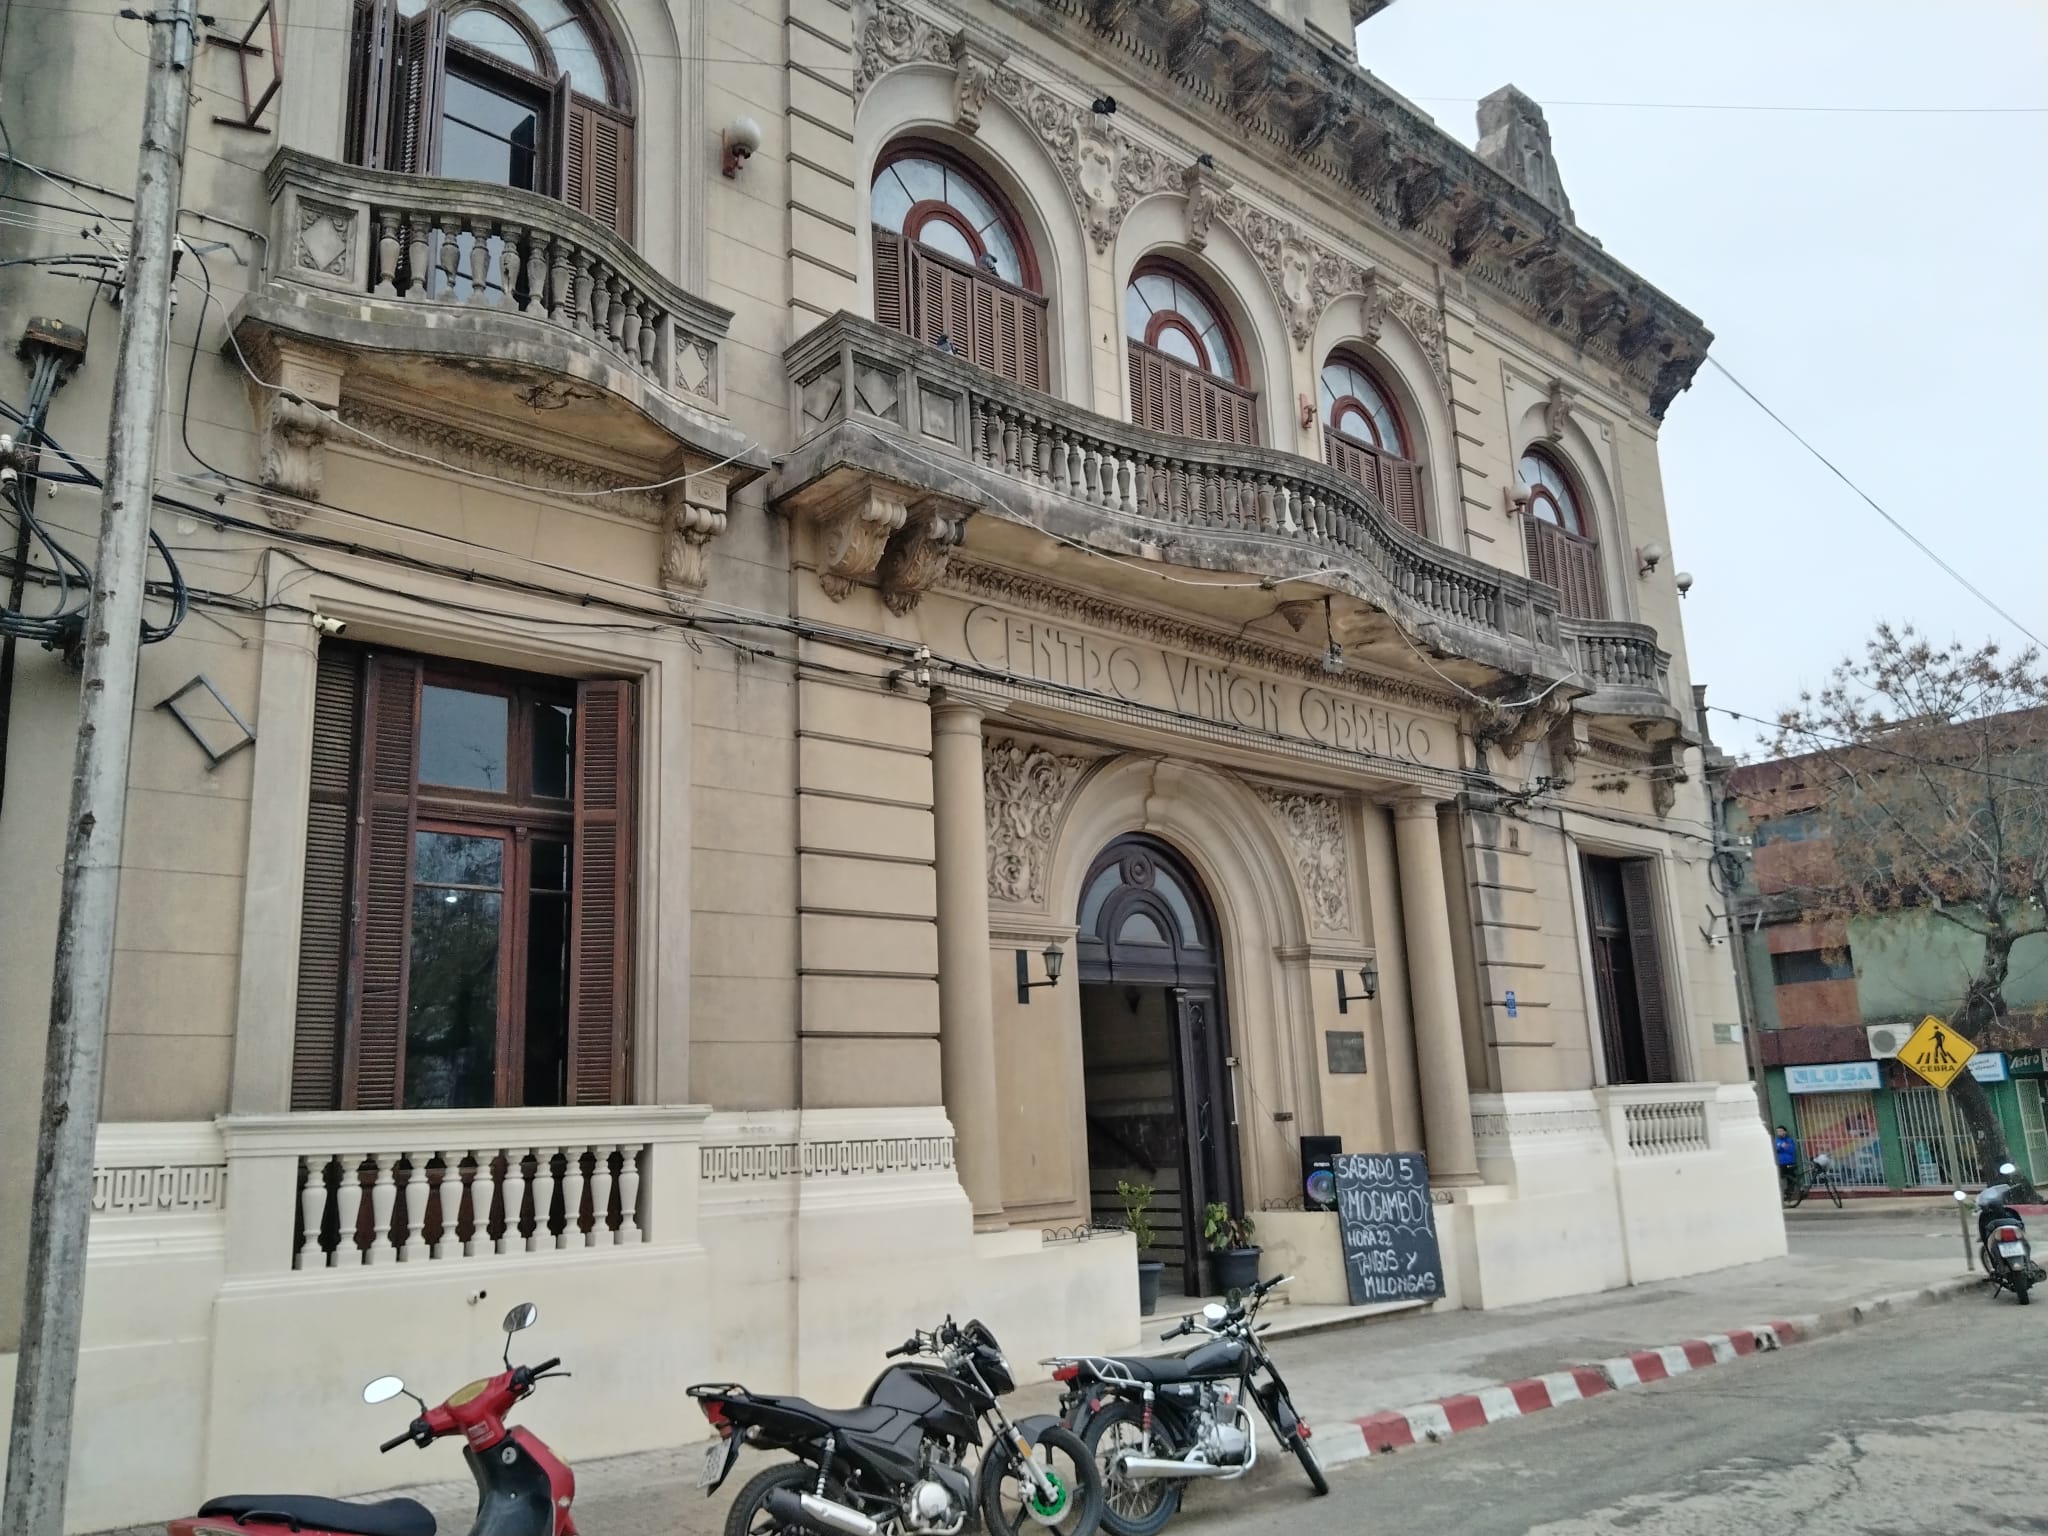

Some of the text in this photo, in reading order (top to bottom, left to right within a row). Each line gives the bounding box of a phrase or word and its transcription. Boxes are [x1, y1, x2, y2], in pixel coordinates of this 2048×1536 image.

[963, 604, 1142, 700] CENTRO
[1300, 687, 1432, 764] OBRERO
[1919, 1065, 1956, 1073] CEBRA
[1399, 1158, 1413, 1180] 5
[1348, 1190, 1424, 1223] MOGAMBO
[1347, 1230, 1393, 1247] HORA 22
[1350, 1249, 1417, 1277] TANGOS Y
[1364, 1271, 1436, 1298] MILONGAS
